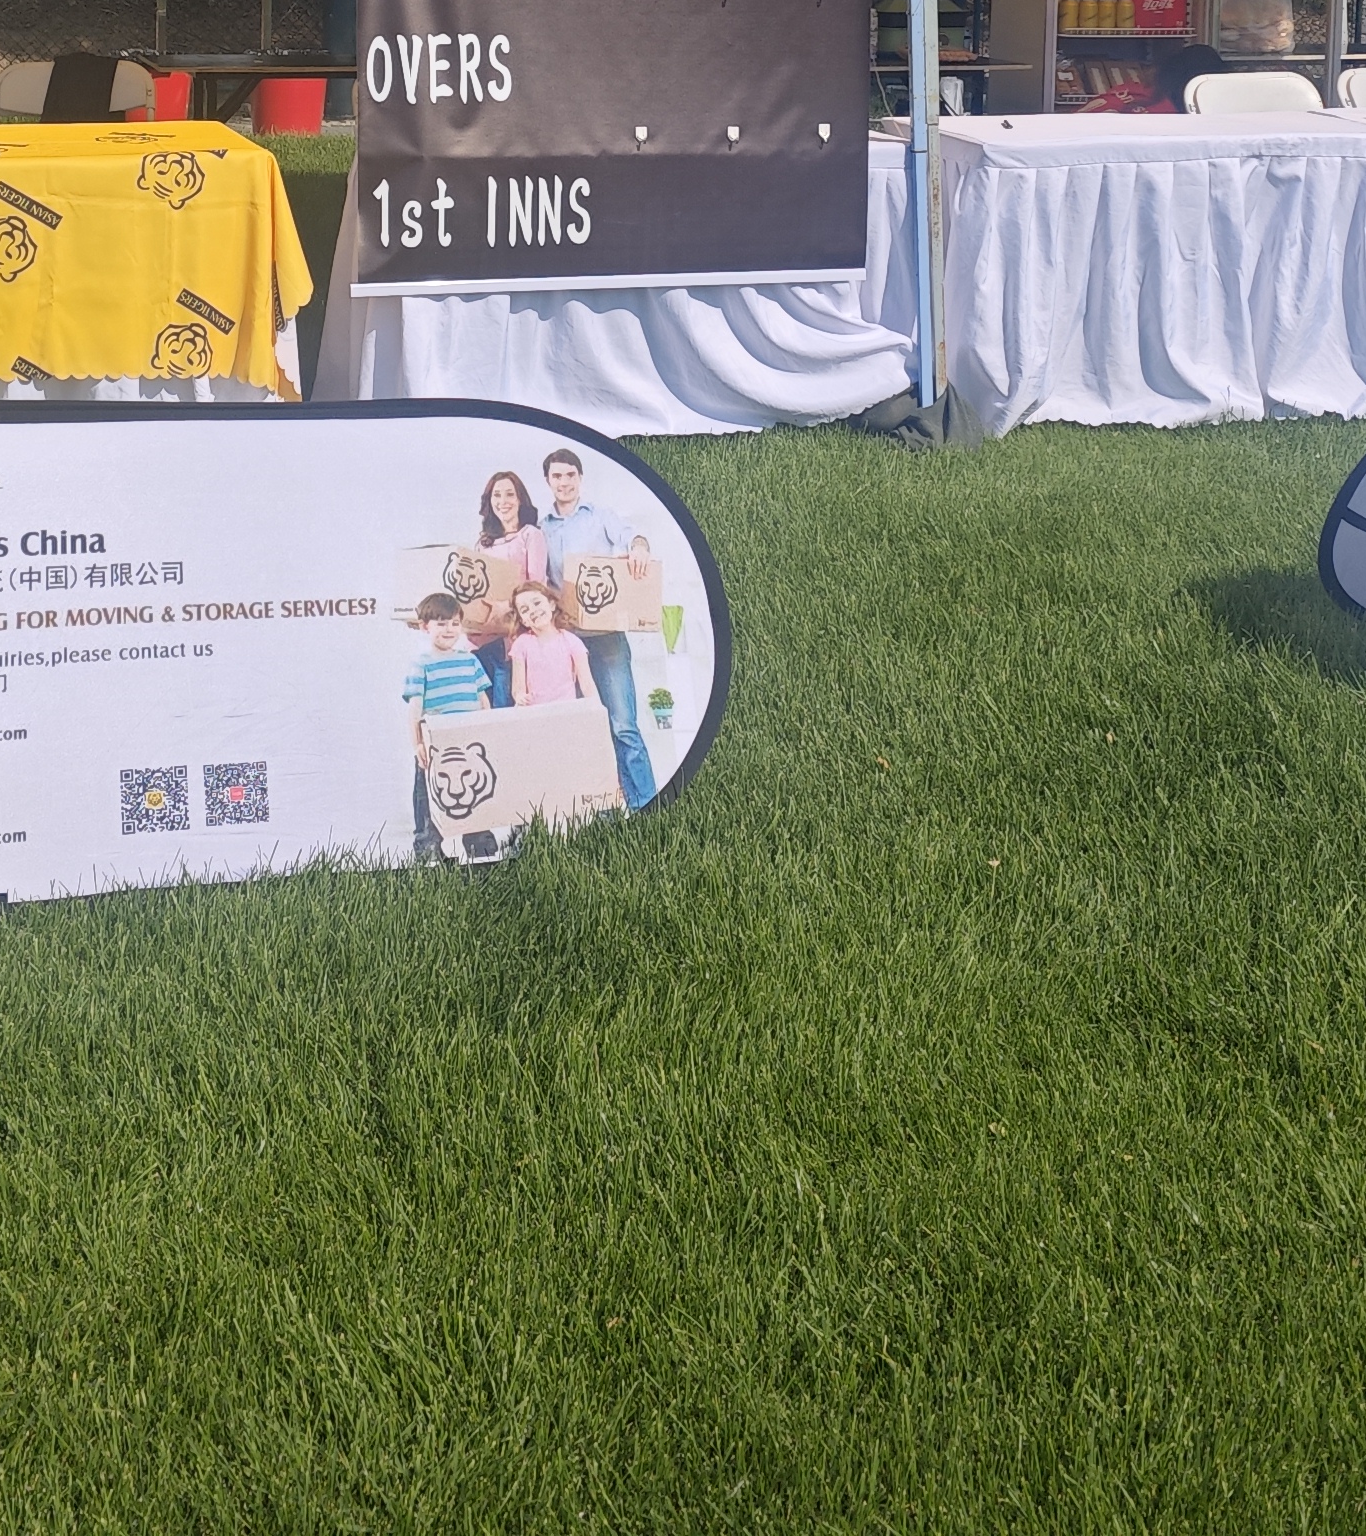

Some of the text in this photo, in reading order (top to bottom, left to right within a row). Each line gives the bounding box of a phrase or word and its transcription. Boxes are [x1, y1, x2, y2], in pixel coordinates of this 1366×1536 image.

[365, 33, 513, 105] OVERS
[27, 202, 60, 228] ASIAN
[372, 174, 592, 249] 1st INNS
[179, 290, 212, 317] TIGERS
[20, 530, 106, 556] China
[15, 610, 58, 630] FOR
[65, 606, 154, 626] MOVING
[161, 606, 176, 623] &
[182, 601, 274, 621] STORAGE
[280, 598, 377, 618] SERVICES?
[119, 642, 185, 661] contact
[193, 643, 214, 657] us
